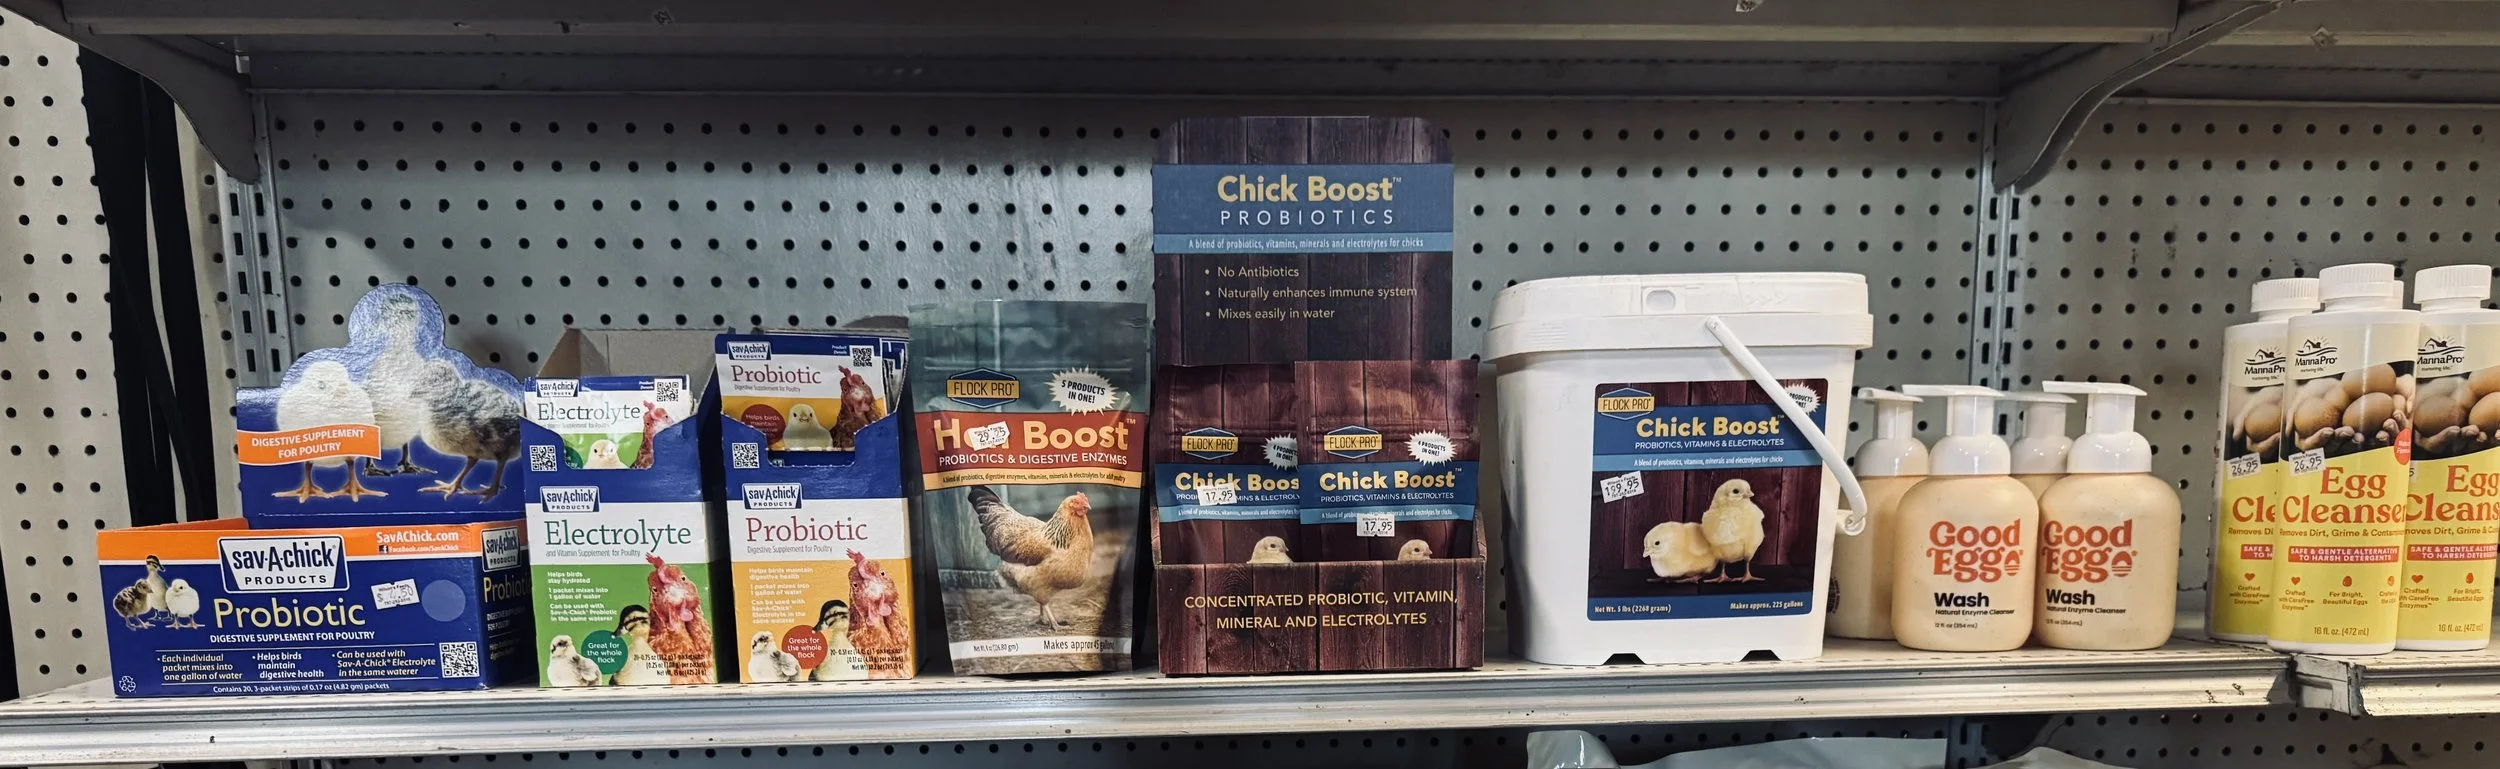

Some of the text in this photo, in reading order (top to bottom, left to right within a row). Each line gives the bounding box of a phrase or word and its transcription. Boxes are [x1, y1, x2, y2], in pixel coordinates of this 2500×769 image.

[1217, 174, 1299, 203] Chick
[1220, 209, 1394, 226] PROBIOTICS
[1195, 236, 1424, 251] blend of probiotics, vitamins, minerals and electrolytes for chicks
[1217, 266, 1300, 277] No Antibiotics
[1217, 286, 1418, 301] Naturally enhances immune system
[1218, 307, 1335, 322] Mixes easily in water
[2295, 354, 2336, 367] MannaPro
[730, 363, 822, 384] Probiotic
[953, 380, 1013, 396] FLOCK PRO
[1067, 380, 1106, 396] PRODUCTS
[1068, 391, 1095, 404] IN ONE!
[1602, 397, 1650, 411] FLOCK PRO
[537, 400, 641, 425] Electrolyte
[1636, 415, 1707, 438] Chick
[251, 428, 367, 448] DIGESTIVE SUPPLEMENT
[1187, 438, 1234, 451] FLOCK PRO
[1329, 435, 1378, 449] FLOCK PRO
[1634, 438, 1785, 450] PROBIOTICS, VITAMINS ELECTROLYTES
[278, 441, 342, 459] FOR POULTRY
[1421, 441, 1446, 453] PRODUCTS
[939, 452, 1128, 467] PROBIOTICS & DIGESTIVE ENZYMES
[1639, 455, 1761, 468] blend probiotics, minerals electrolytes
[2293, 457, 2323, 472] 26.95
[2231, 460, 2259, 475] 26.95
[1319, 470, 1389, 492] Chick
[1604, 477, 1640, 496] 199.95
[2320, 466, 2388, 500] Egg
[1205, 489, 1234, 502] 17.95
[1366, 493, 1400, 501] VITAMINS
[1407, 492, 1455, 500] ELECTROLYTES
[745, 515, 869, 543] Probiotic
[1364, 520, 1394, 533] 17.95
[1929, 517, 2022, 548] Good
[2043, 517, 2133, 548] Good
[2433, 526, 2482, 536] Dirt, Grime
[376, 529, 460, 544] SavAChick.com
[544, 518, 692, 553] Electrolyte
[2309, 529, 2329, 538] Dirt,
[2331, 529, 2360, 537] Grime
[557, 549, 641, 558] Vitamin Supplement Poultry
[747, 545, 833, 556] Digestive Supplement Poultry
[2317, 548, 2352, 556] GENTLE
[2443, 545, 2475, 553] GENTLE
[2311, 554, 2392, 562] HARSH DETERGENTS
[2435, 552, 2466, 560] HARSH
[1926, 545, 2007, 584] Egg
[2041, 545, 2114, 584] Egg
[244, 574, 328, 586] PRODUCTS
[1184, 590, 1459, 610] CONCENTRATED PROBIOTIC, VITAMIN,
[1934, 591, 1991, 608] Wash
[2045, 588, 2097, 606] Wash
[213, 596, 366, 630] Probiotic
[1935, 608, 1988, 617] Natural Enzyme
[2067, 606, 2128, 615] Enzyme Cleanser
[1216, 612, 1428, 630] MINERAL AND ELECTROLYTES
[209, 630, 376, 644] DIGESTIVE SUPPLEMENT FOR POULTRY
[789, 637, 809, 645] Great
[588, 642, 609, 650] Great
[800, 644, 822, 652] whole
[1043, 639, 1069, 650] Makes
[161, 653, 225, 663] Each individual
[257, 651, 302, 663] Helps birds
[336, 649, 406, 659] Can be used with
[600, 649, 623, 657] whole
[162, 662, 234, 673] packet mixes into
[257, 661, 296, 670] maintain
[392, 658, 437, 668] Electrolyte
[164, 672, 243, 683] one gallon of water
[259, 669, 325, 681] digestive health
[338, 668, 419, 677] in the same waterer
[212, 685, 242, 694] Contains
